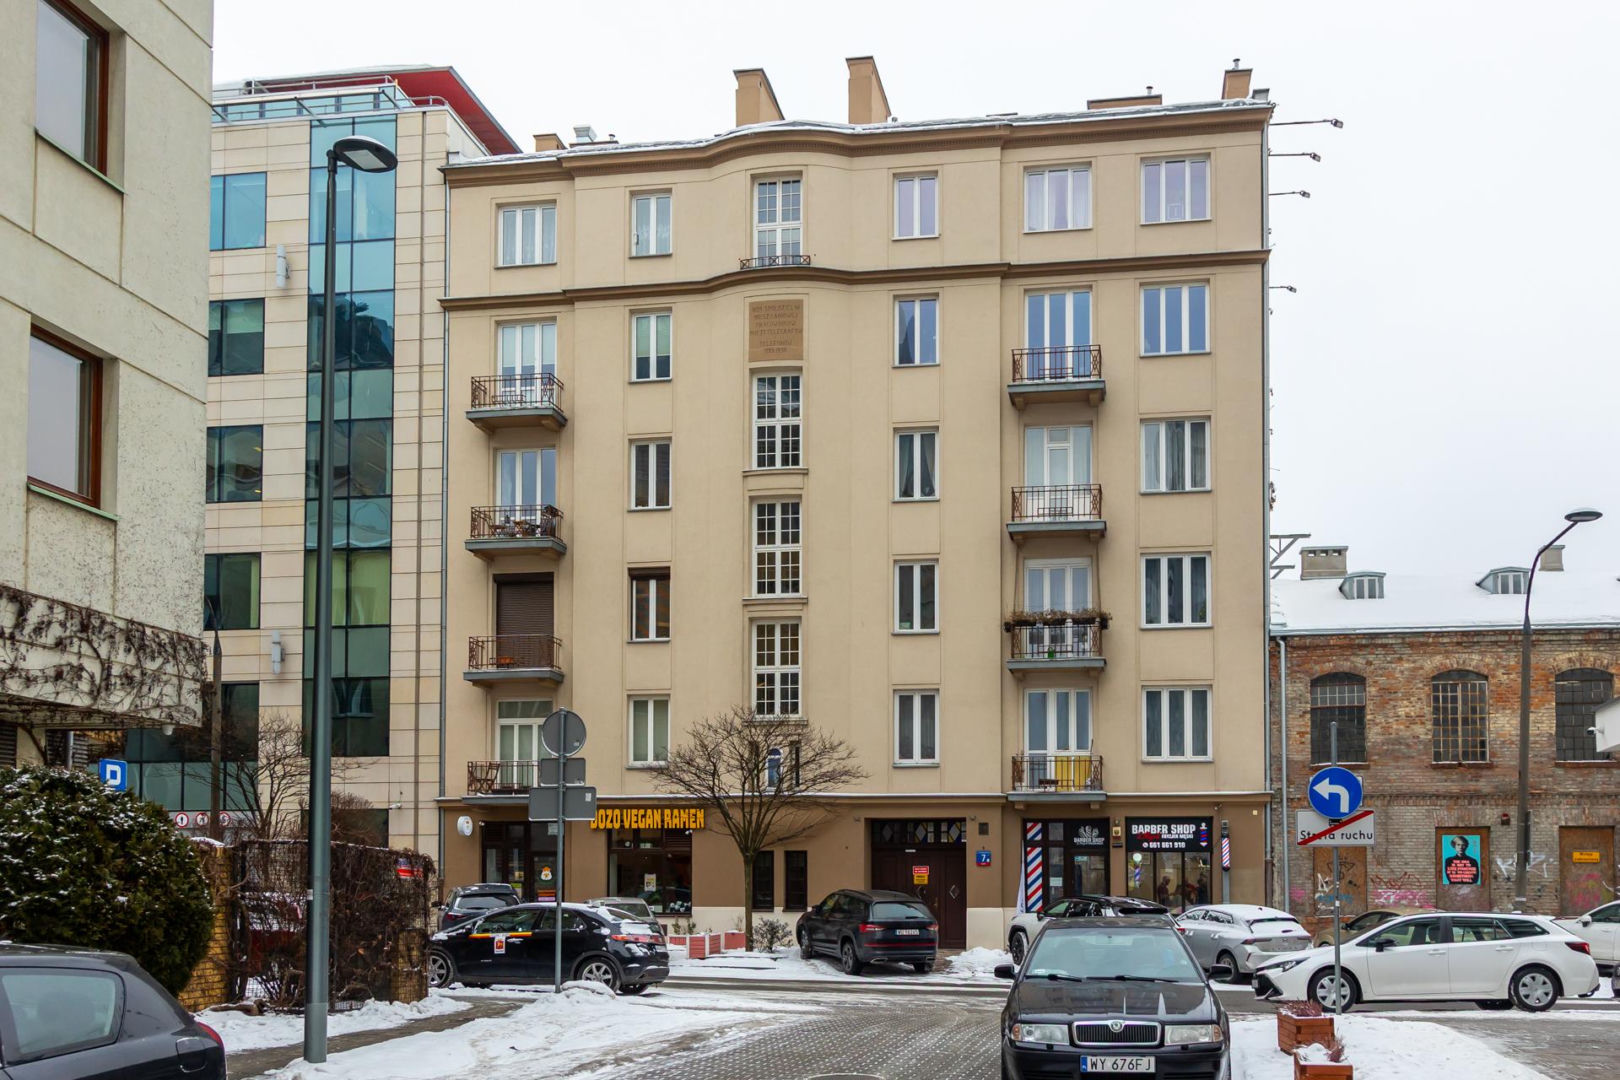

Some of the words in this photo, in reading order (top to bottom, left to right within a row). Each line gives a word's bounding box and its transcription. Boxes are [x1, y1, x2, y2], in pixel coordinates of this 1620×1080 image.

[623, 808, 662, 829] VEGAN
[664, 808, 705, 829] RAMEN
[1131, 824, 1168, 834] BARBER
[1170, 824, 1197, 834] SHOP
[1341, 830, 1373, 840] ruchu
[1090, 1058, 1106, 1070] WY
[1111, 1058, 1151, 1071] 676FJ
